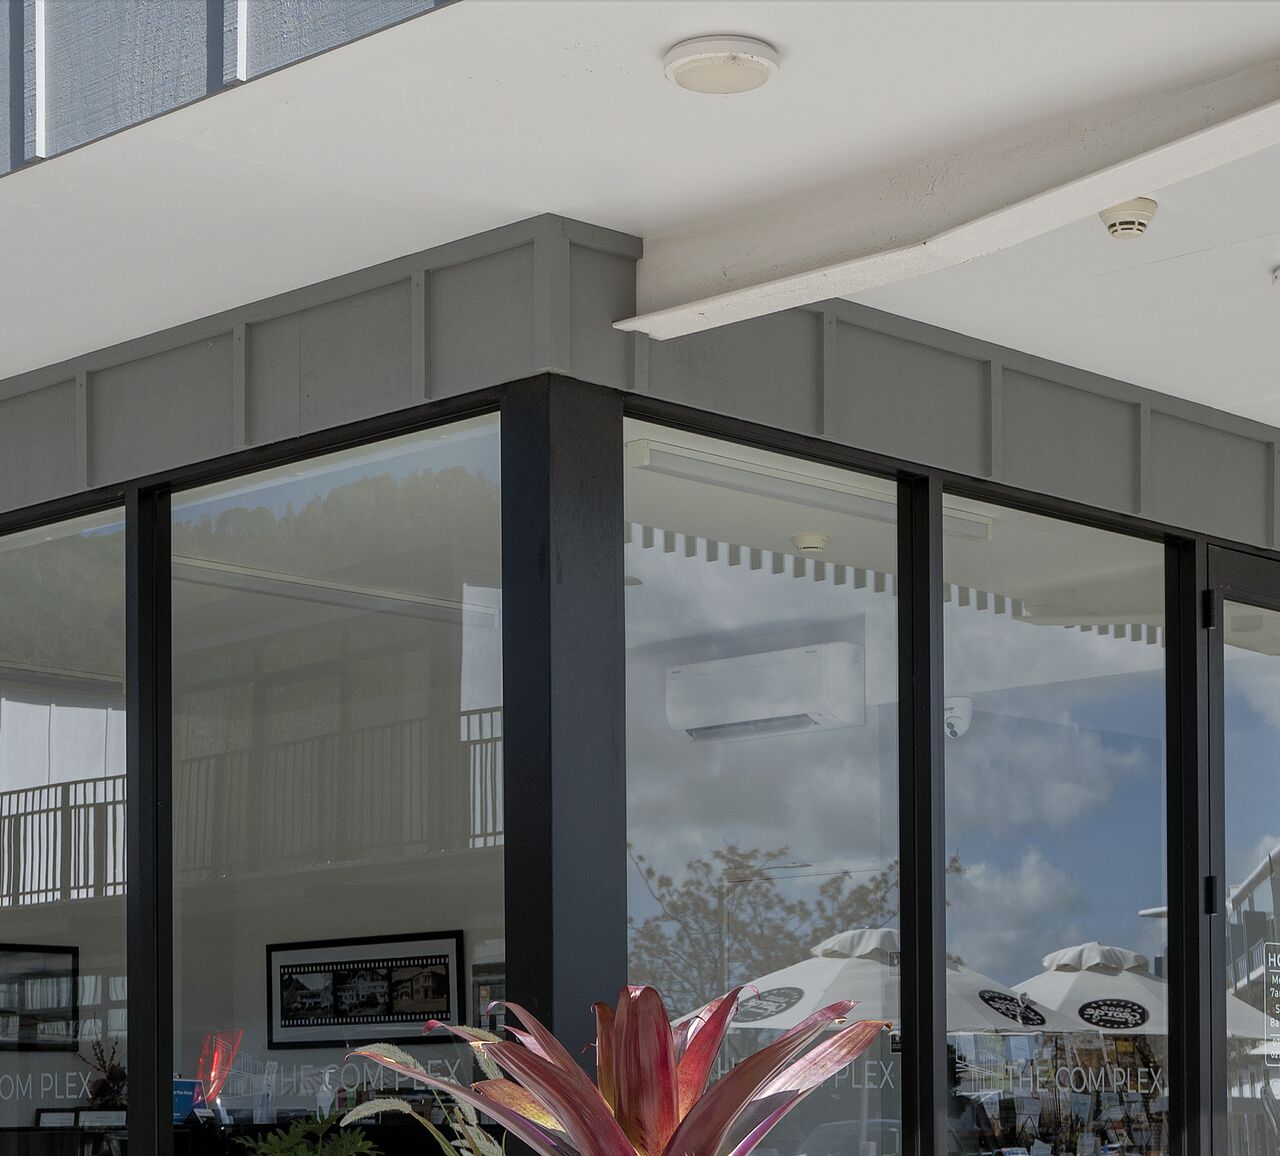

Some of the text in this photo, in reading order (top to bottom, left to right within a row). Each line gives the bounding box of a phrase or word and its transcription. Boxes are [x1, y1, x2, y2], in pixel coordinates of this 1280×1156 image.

[40, 1071, 93, 1100] PLEX
[321, 1061, 384, 1094] COM
[1007, 1065, 1163, 1094] THE COM PLEX
